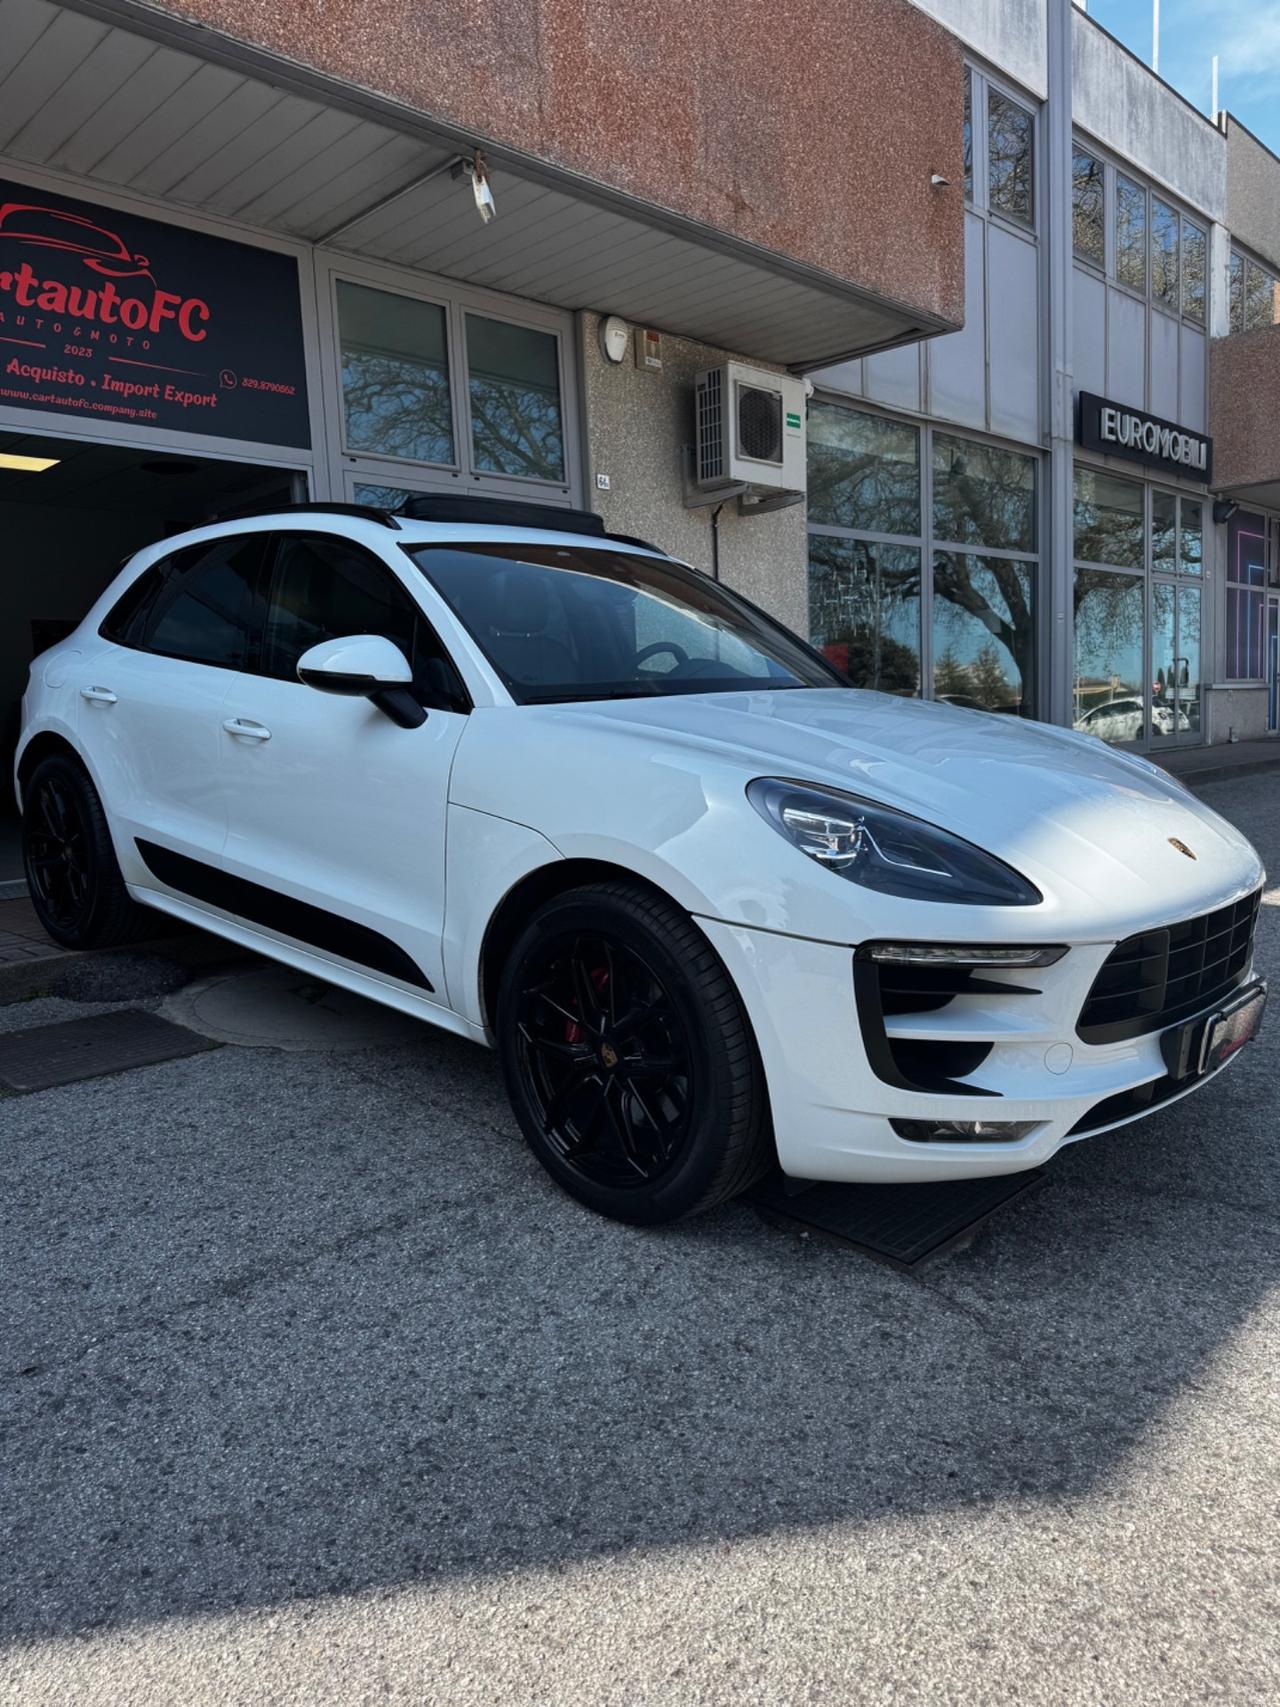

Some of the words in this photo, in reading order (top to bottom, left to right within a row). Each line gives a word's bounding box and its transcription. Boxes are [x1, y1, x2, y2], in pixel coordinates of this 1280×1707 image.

[64, 344, 94, 358] 2023
[0, 387, 158, 419] www.cartautofc.company.site
[6, 358, 85, 388] Acquisto
[101, 374, 161, 399] Import
[164, 385, 218, 408] Export
[1100, 407, 1207, 471] EUROMOBILI
